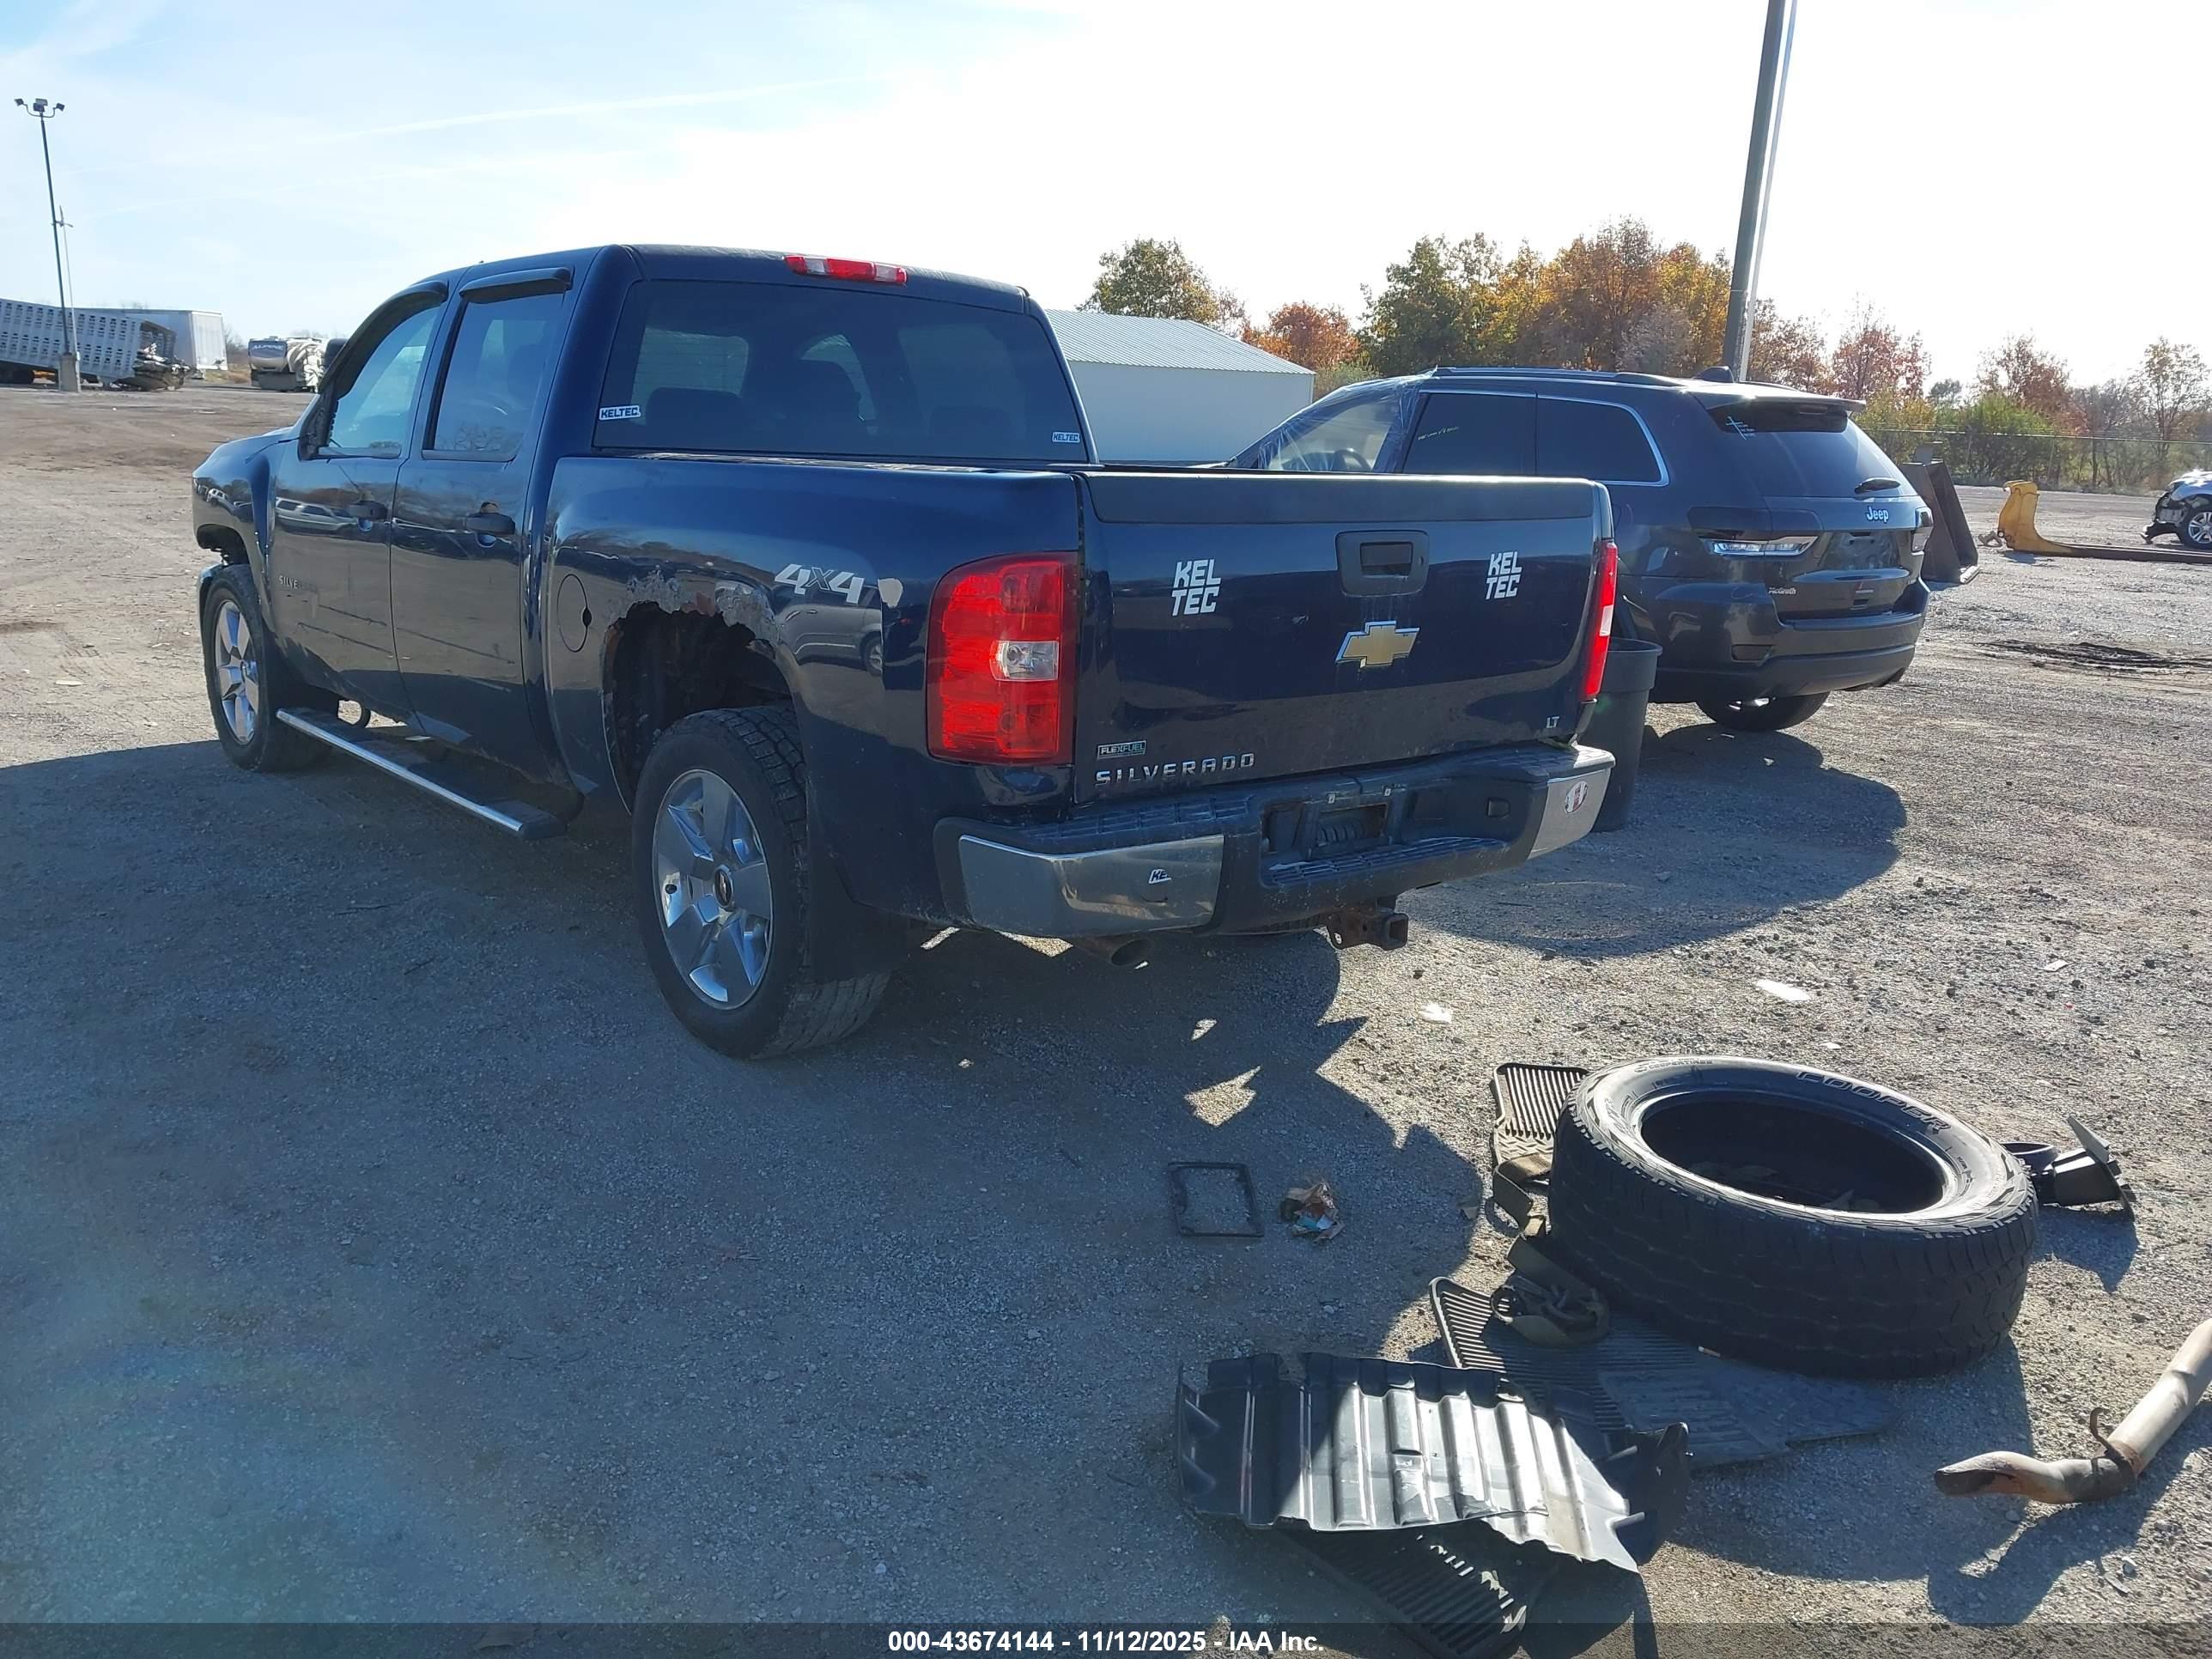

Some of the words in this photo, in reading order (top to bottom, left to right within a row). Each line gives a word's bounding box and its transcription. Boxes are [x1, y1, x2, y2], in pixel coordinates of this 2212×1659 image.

[600, 406, 639, 419] KELTEC
[1053, 432, 1079, 441] KELTEC
[1866, 506, 1889, 523] Jeep
[1173, 558, 1222, 588] KEL
[1487, 550, 1522, 576] KEL
[1486, 574, 1522, 600] TEC
[1171, 586, 1220, 617] TEC
[1546, 715, 1560, 729] LT
[1099, 742, 1146, 756] FLEXFUEL
[1095, 753, 1255, 786] SILVERADO
[1795, 1070, 1951, 1133] COOPER
